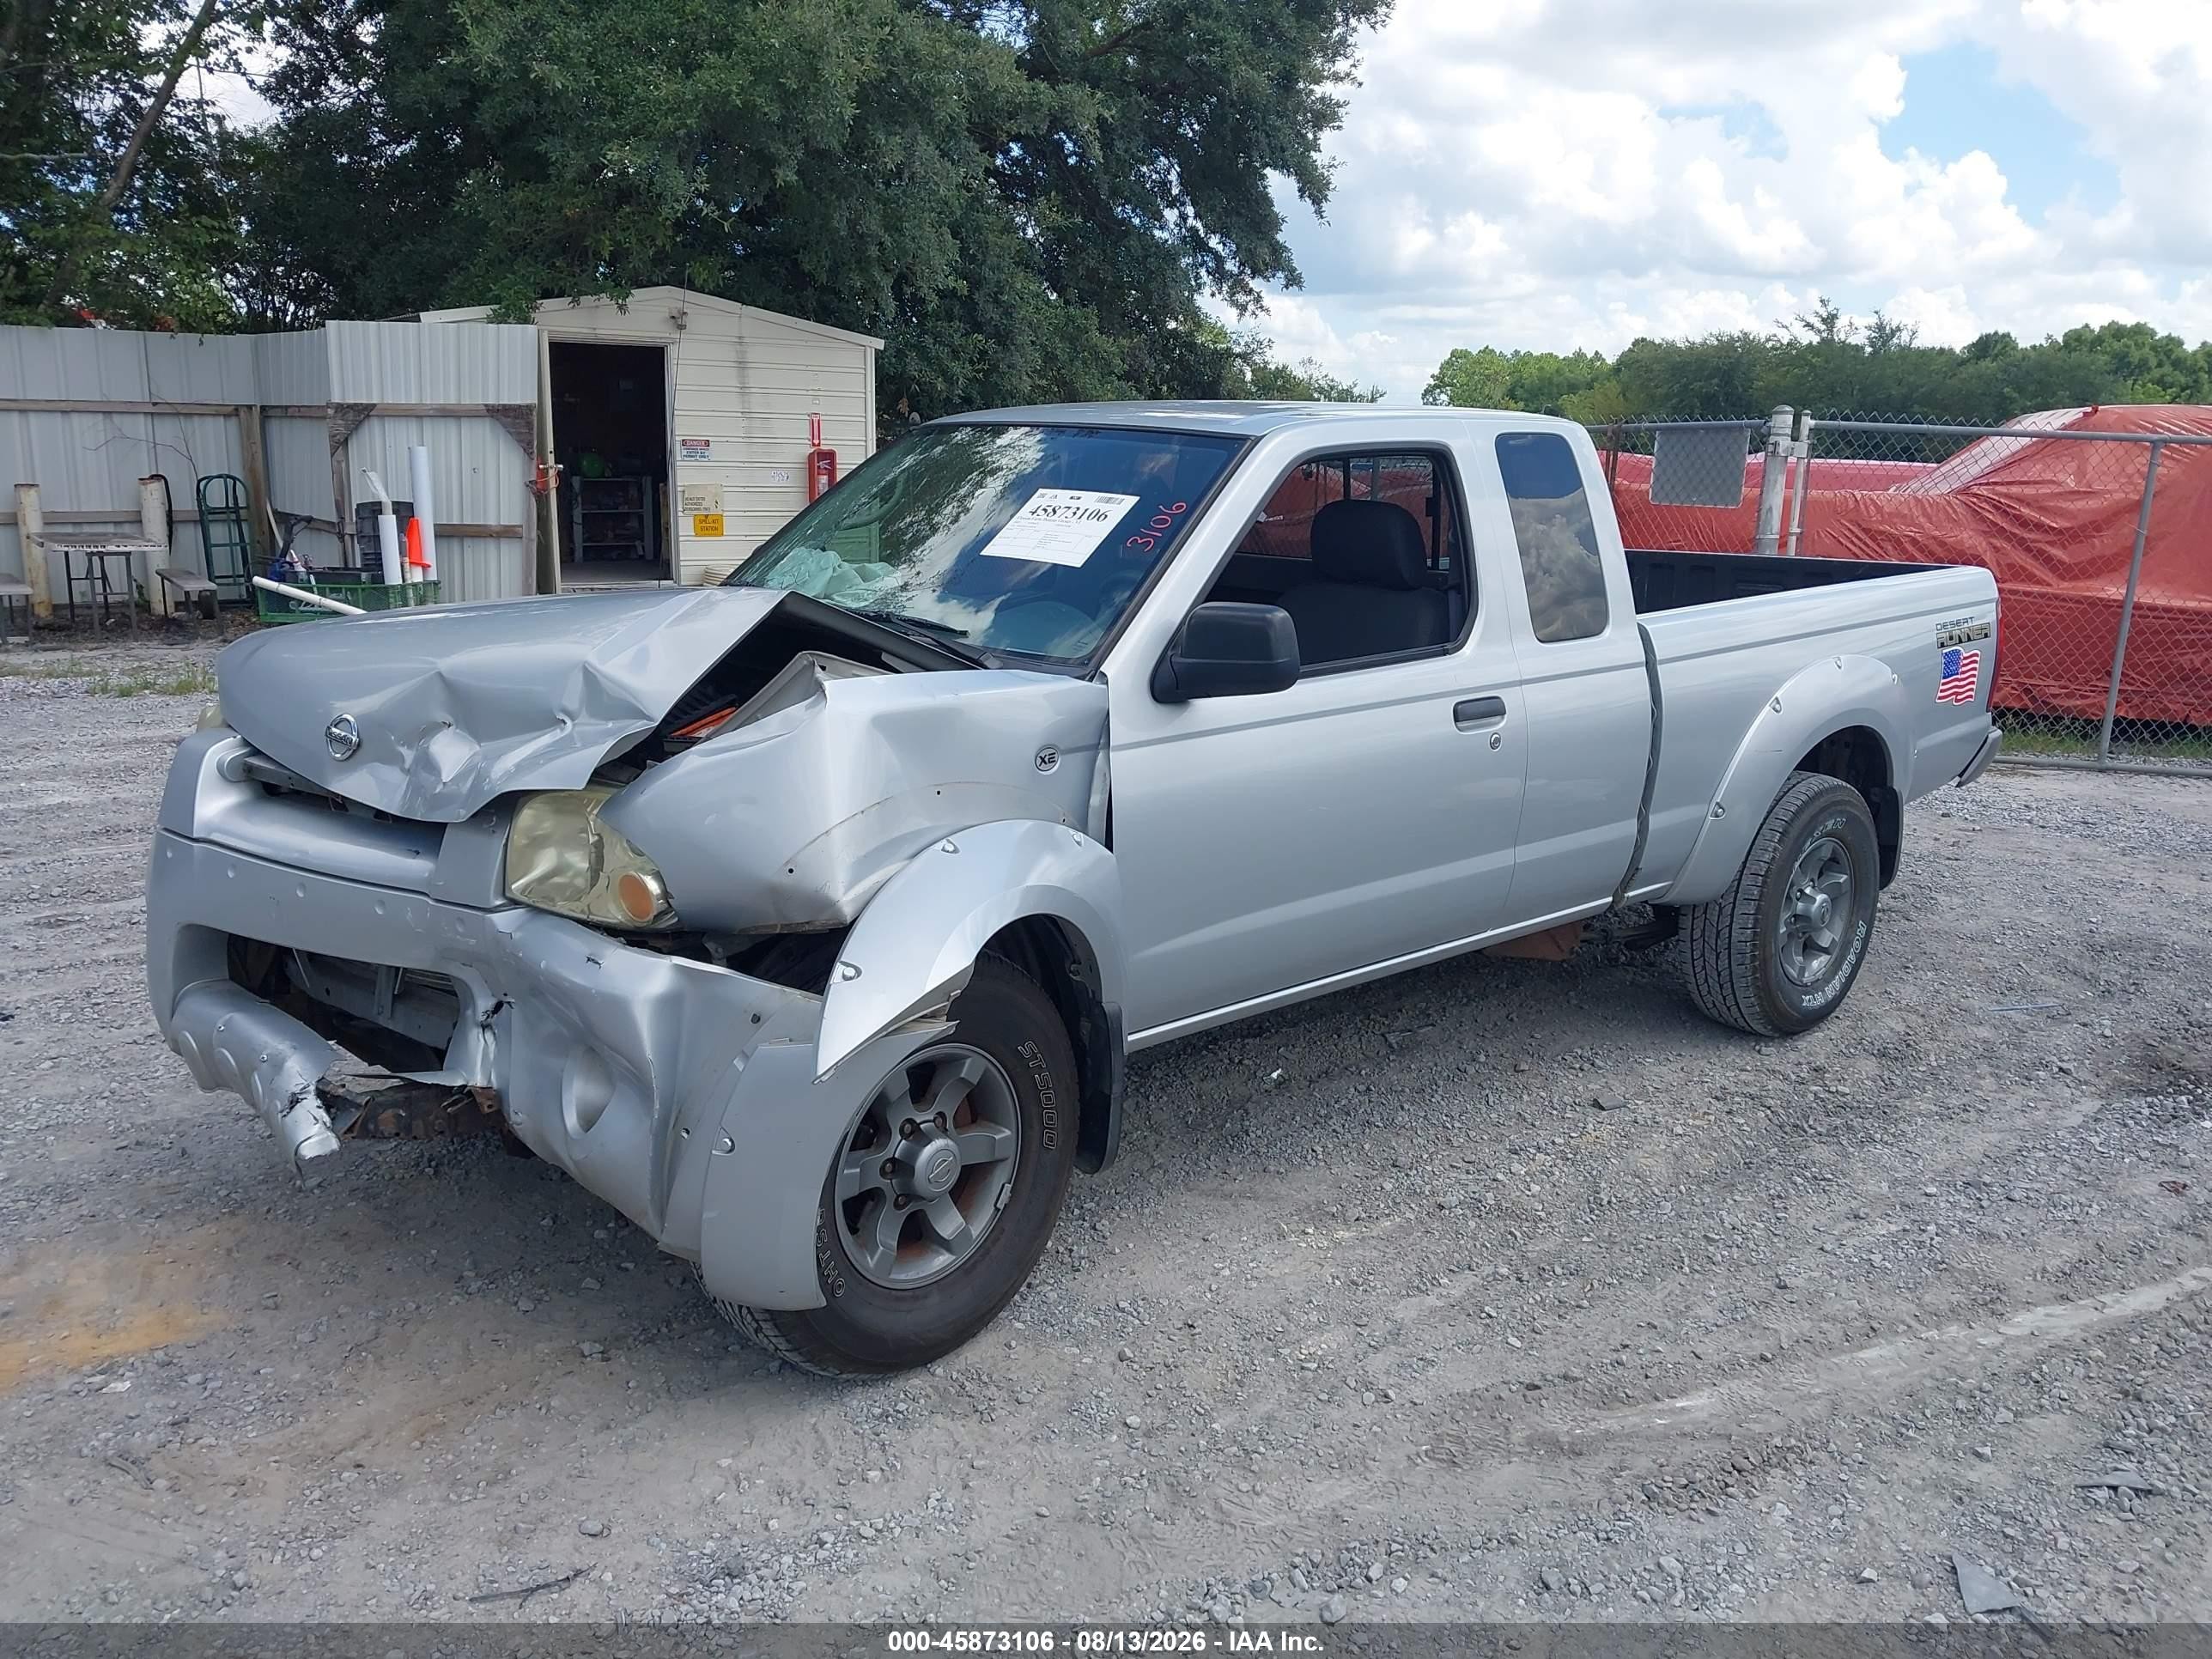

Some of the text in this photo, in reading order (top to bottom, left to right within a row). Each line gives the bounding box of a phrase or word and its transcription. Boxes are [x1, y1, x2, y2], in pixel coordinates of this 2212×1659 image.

[1029, 504, 1113, 523] 45873106
[1126, 501, 1188, 552] 3106
[1936, 617, 1975, 631] DESERT
[1936, 623, 1990, 648] RUNNER
[1038, 752, 1056, 767] XE
[1802, 920, 1867, 1006] ROADIAN HTX
[1018, 1040, 1058, 1150] ST5000
